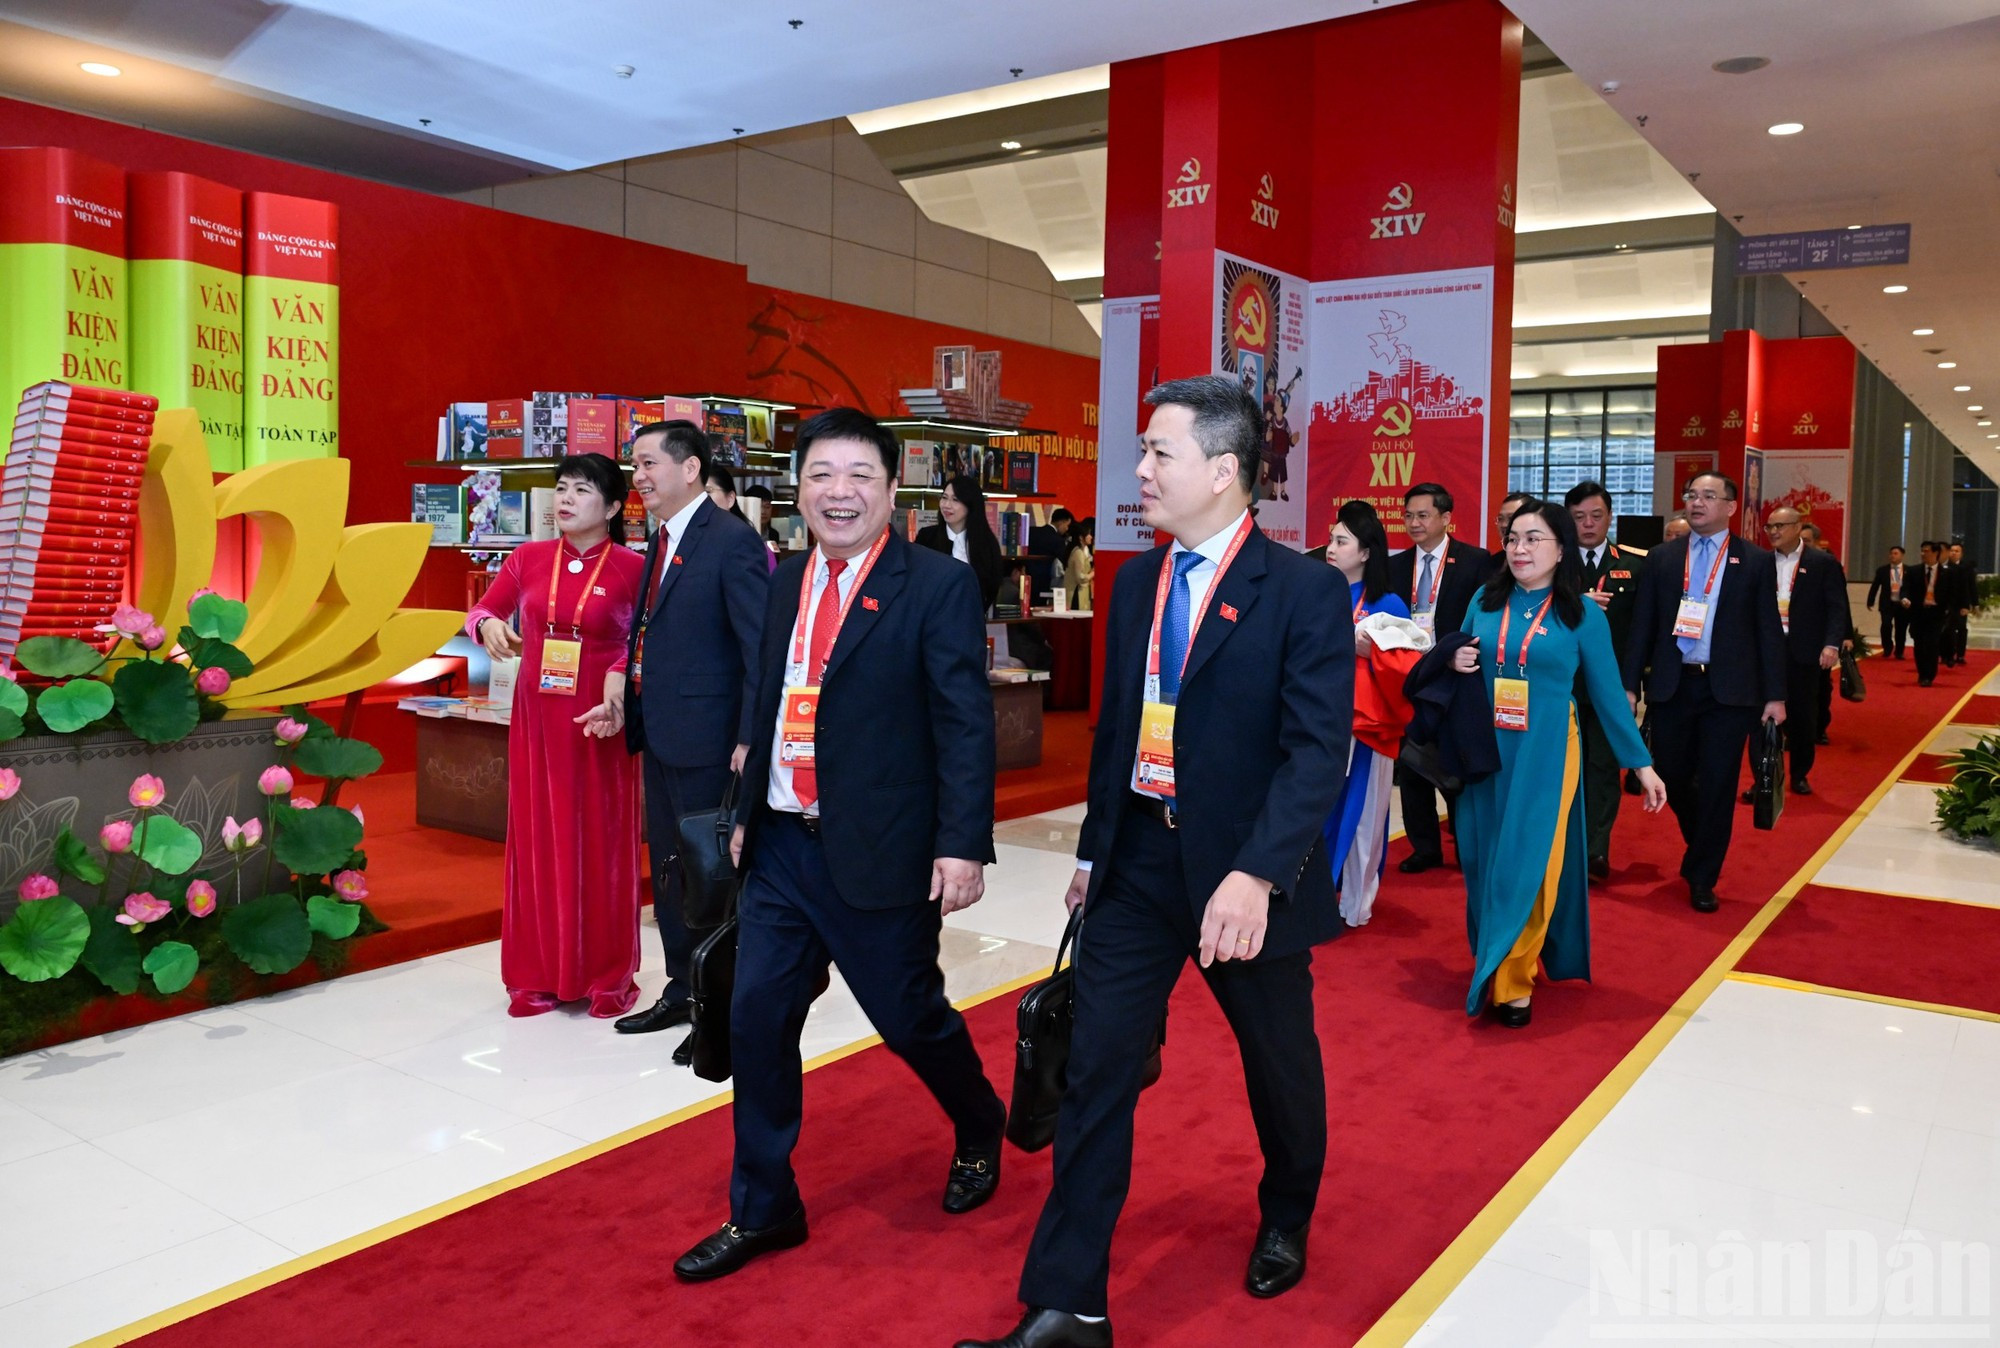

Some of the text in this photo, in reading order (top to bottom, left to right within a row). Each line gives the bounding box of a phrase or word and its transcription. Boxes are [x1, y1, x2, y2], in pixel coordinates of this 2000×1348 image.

[1167, 184, 1210, 208] XIV
[94, 215, 112, 228] NAM
[1251, 199, 1279, 230] XIV
[1370, 212, 1426, 239] XIV
[220, 236, 236, 248] NAM
[233, 228, 243, 238] SẢ
[258, 231, 336, 250] ĐẢNG CỘNG SẢN
[1807, 239, 1828, 248] TẦNG
[274, 244, 322, 258] VIỆT NAM
[1812, 250, 1829, 262] 2F
[71, 264, 114, 300] VĂN
[200, 282, 238, 316] VĂN
[271, 293, 324, 325] VĂN
[67, 311, 118, 347] KIỆN
[196, 324, 241, 359] KIỆN
[266, 335, 329, 368] KIỆN
[60, 348, 122, 385] ĐẢNG
[192, 360, 243, 394] ĐẢNG
[261, 369, 334, 401] ĐẢNG
[675, 402, 692, 414] SÁCH
[257, 424, 337, 446] TOÀN TẬP
[1722, 420, 1743, 428] XIV
[1792, 424, 1819, 435] XIV
[1044, 435, 1062, 460] ĐẠI
[1066, 434, 1084, 462] HỘI
[1372, 439, 1413, 452] ĐẠI HỘI
[1368, 452, 1416, 487] XIV
[1380, 496, 1396, 507] VIỆT
[1387, 524, 1406, 533] MINH
